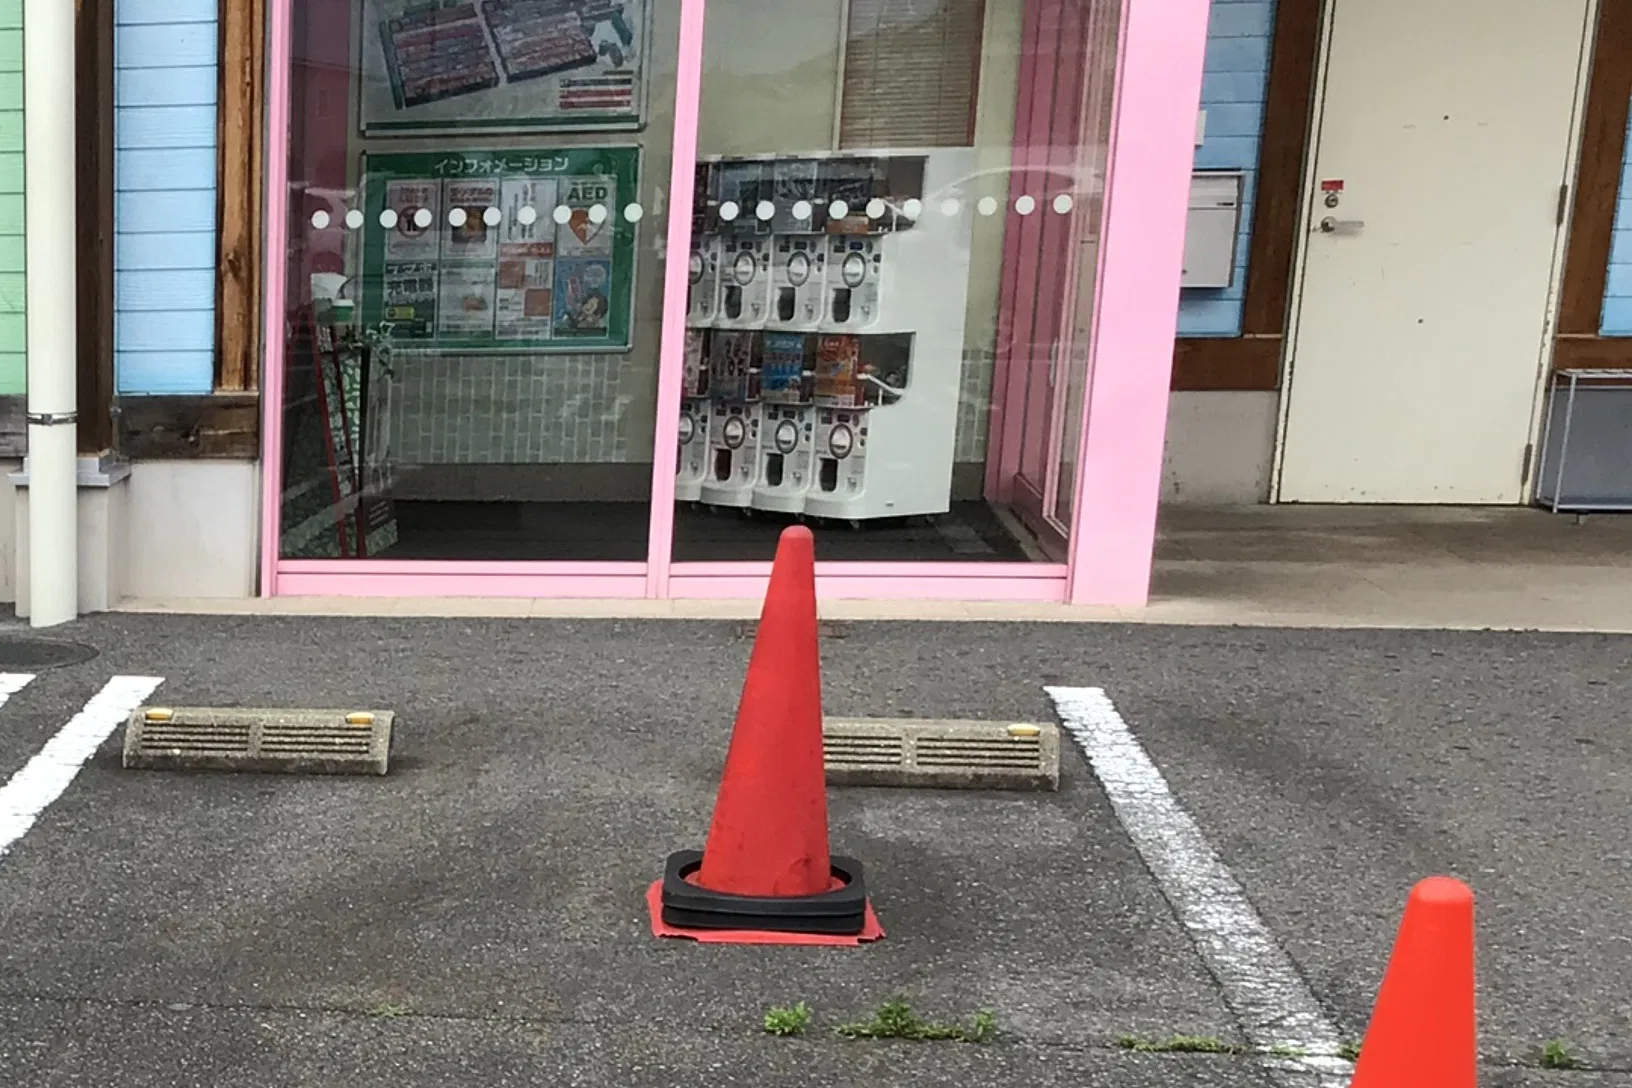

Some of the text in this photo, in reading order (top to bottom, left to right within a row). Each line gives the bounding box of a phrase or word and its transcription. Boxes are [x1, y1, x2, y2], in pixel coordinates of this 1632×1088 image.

[435, 156, 569, 174] インフォメーション
[567, 186, 608, 201] AED
